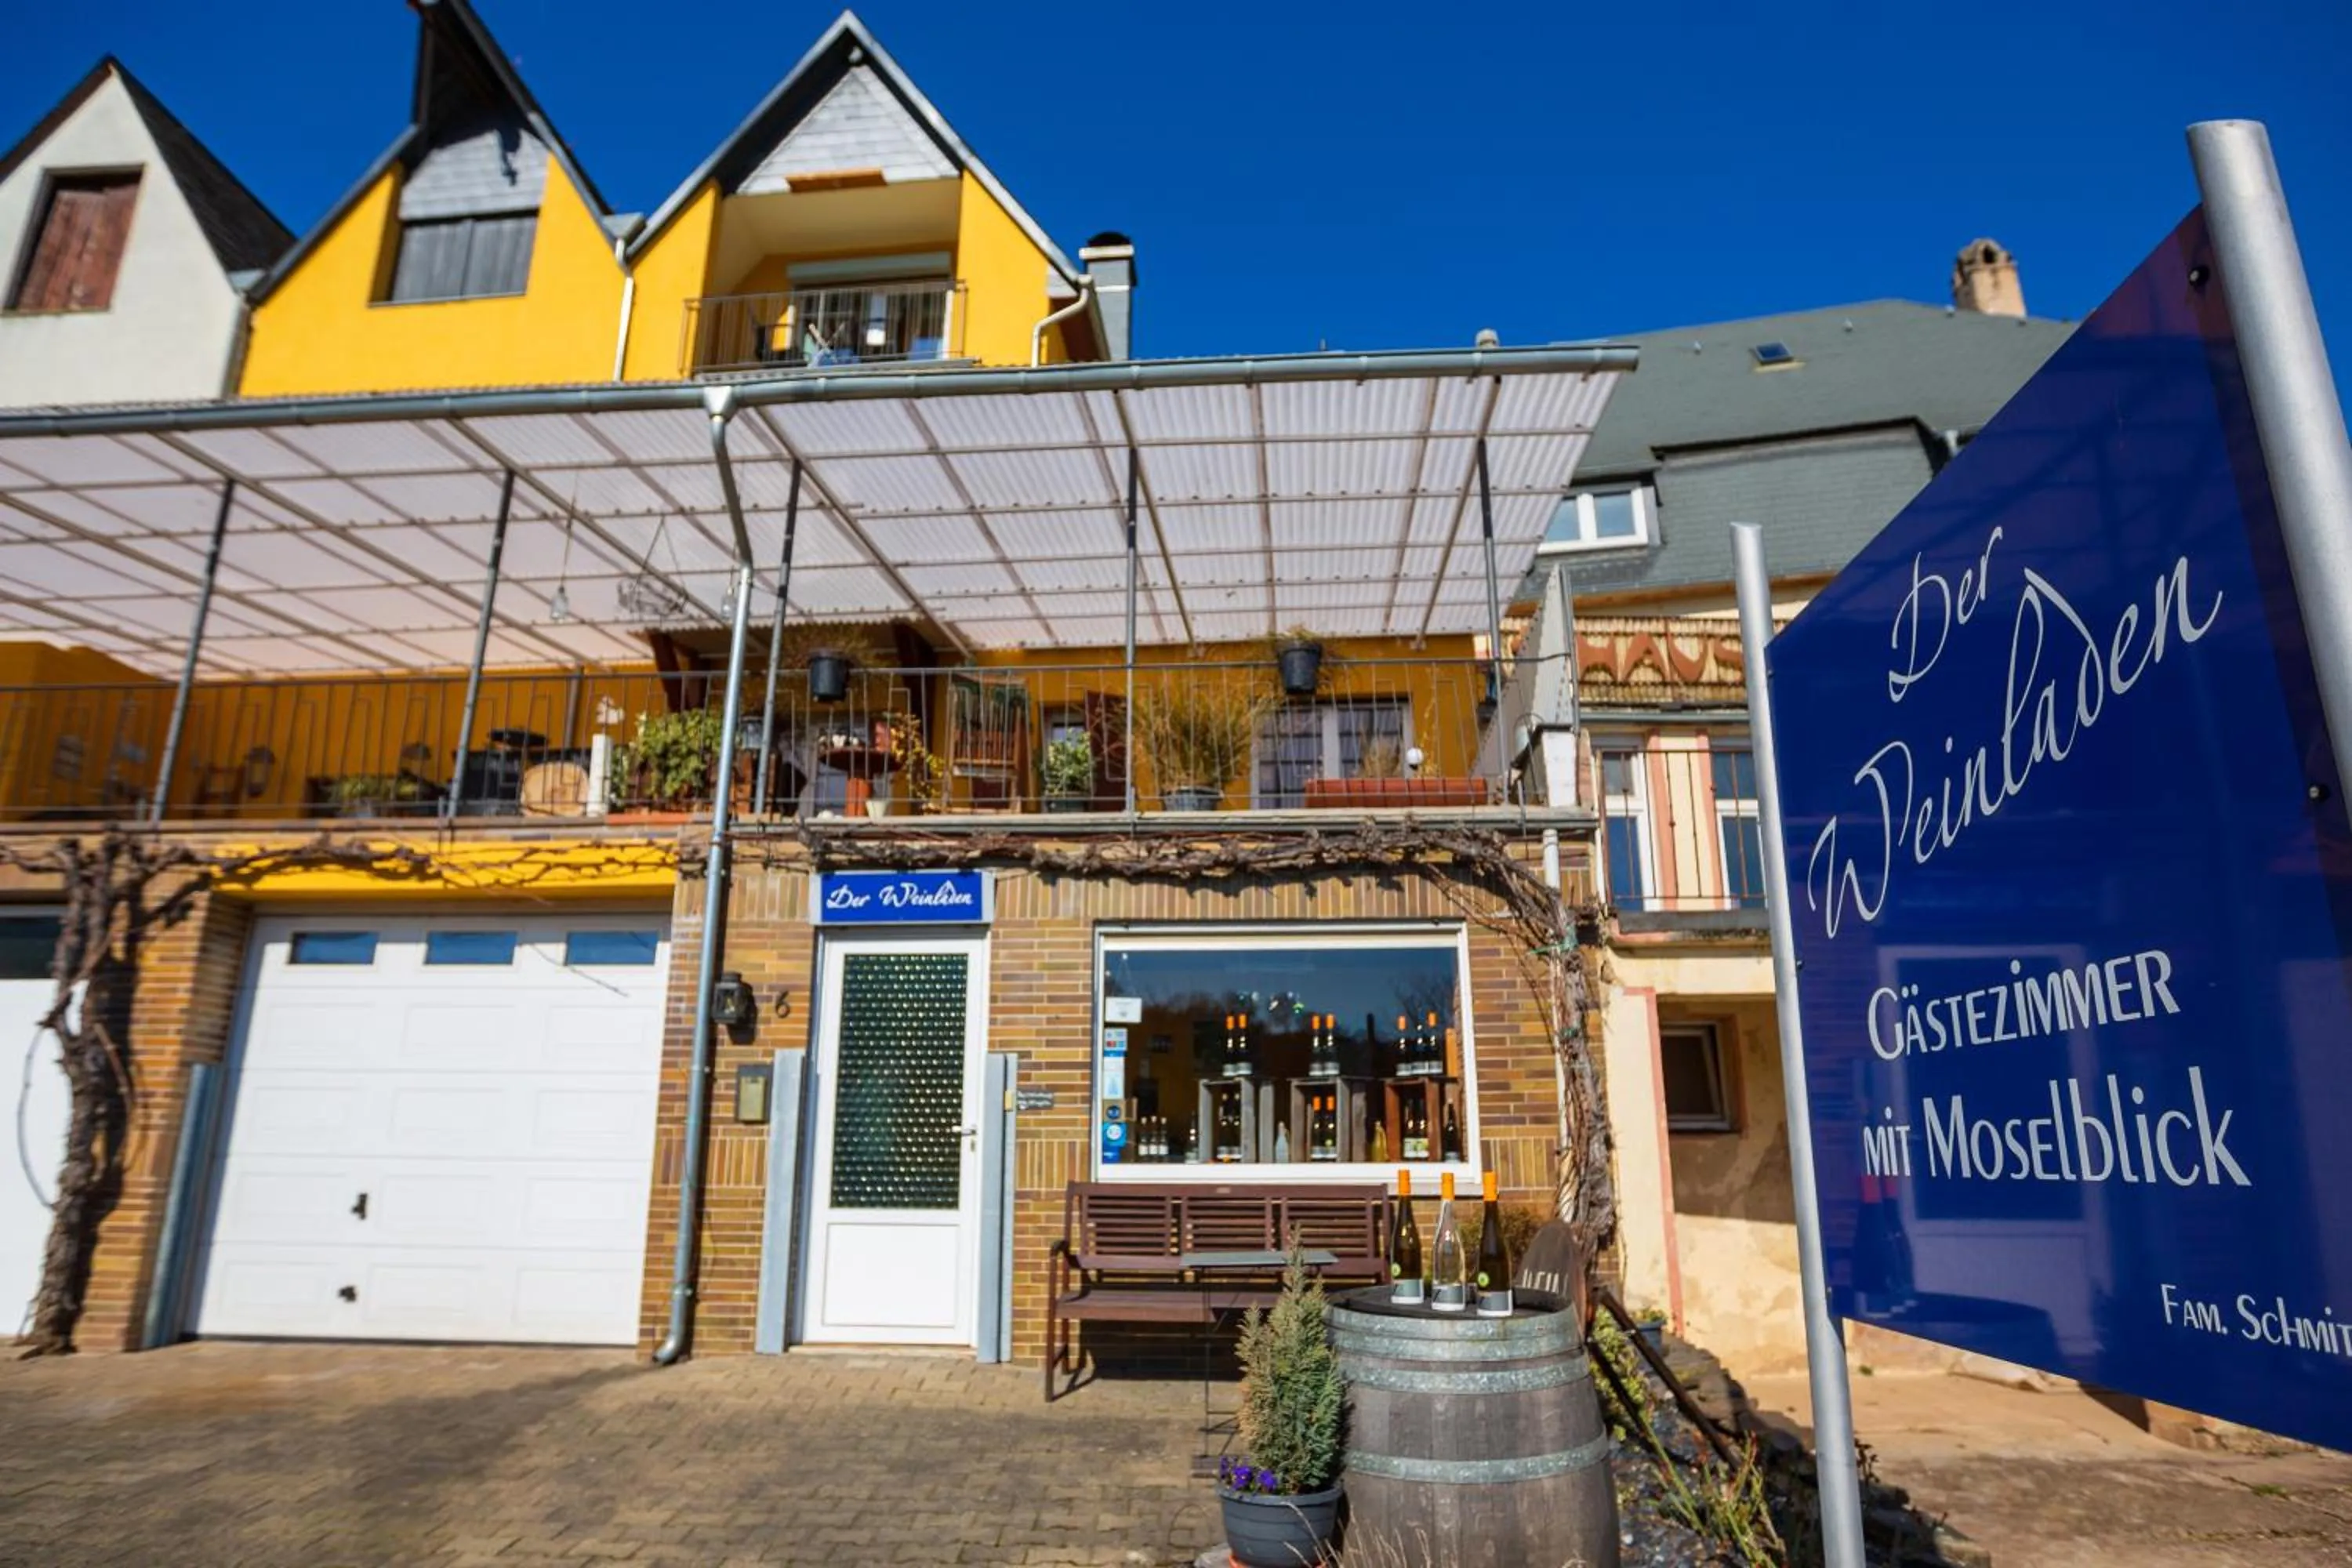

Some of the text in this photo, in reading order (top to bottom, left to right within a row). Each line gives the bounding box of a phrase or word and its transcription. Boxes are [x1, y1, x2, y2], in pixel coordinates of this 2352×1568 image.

[1889, 526, 2003, 702] Der
[1808, 556, 2223, 939] Weinladen
[826, 880, 974, 909] Der Weinladen
[775, 990, 791, 1019] 6
